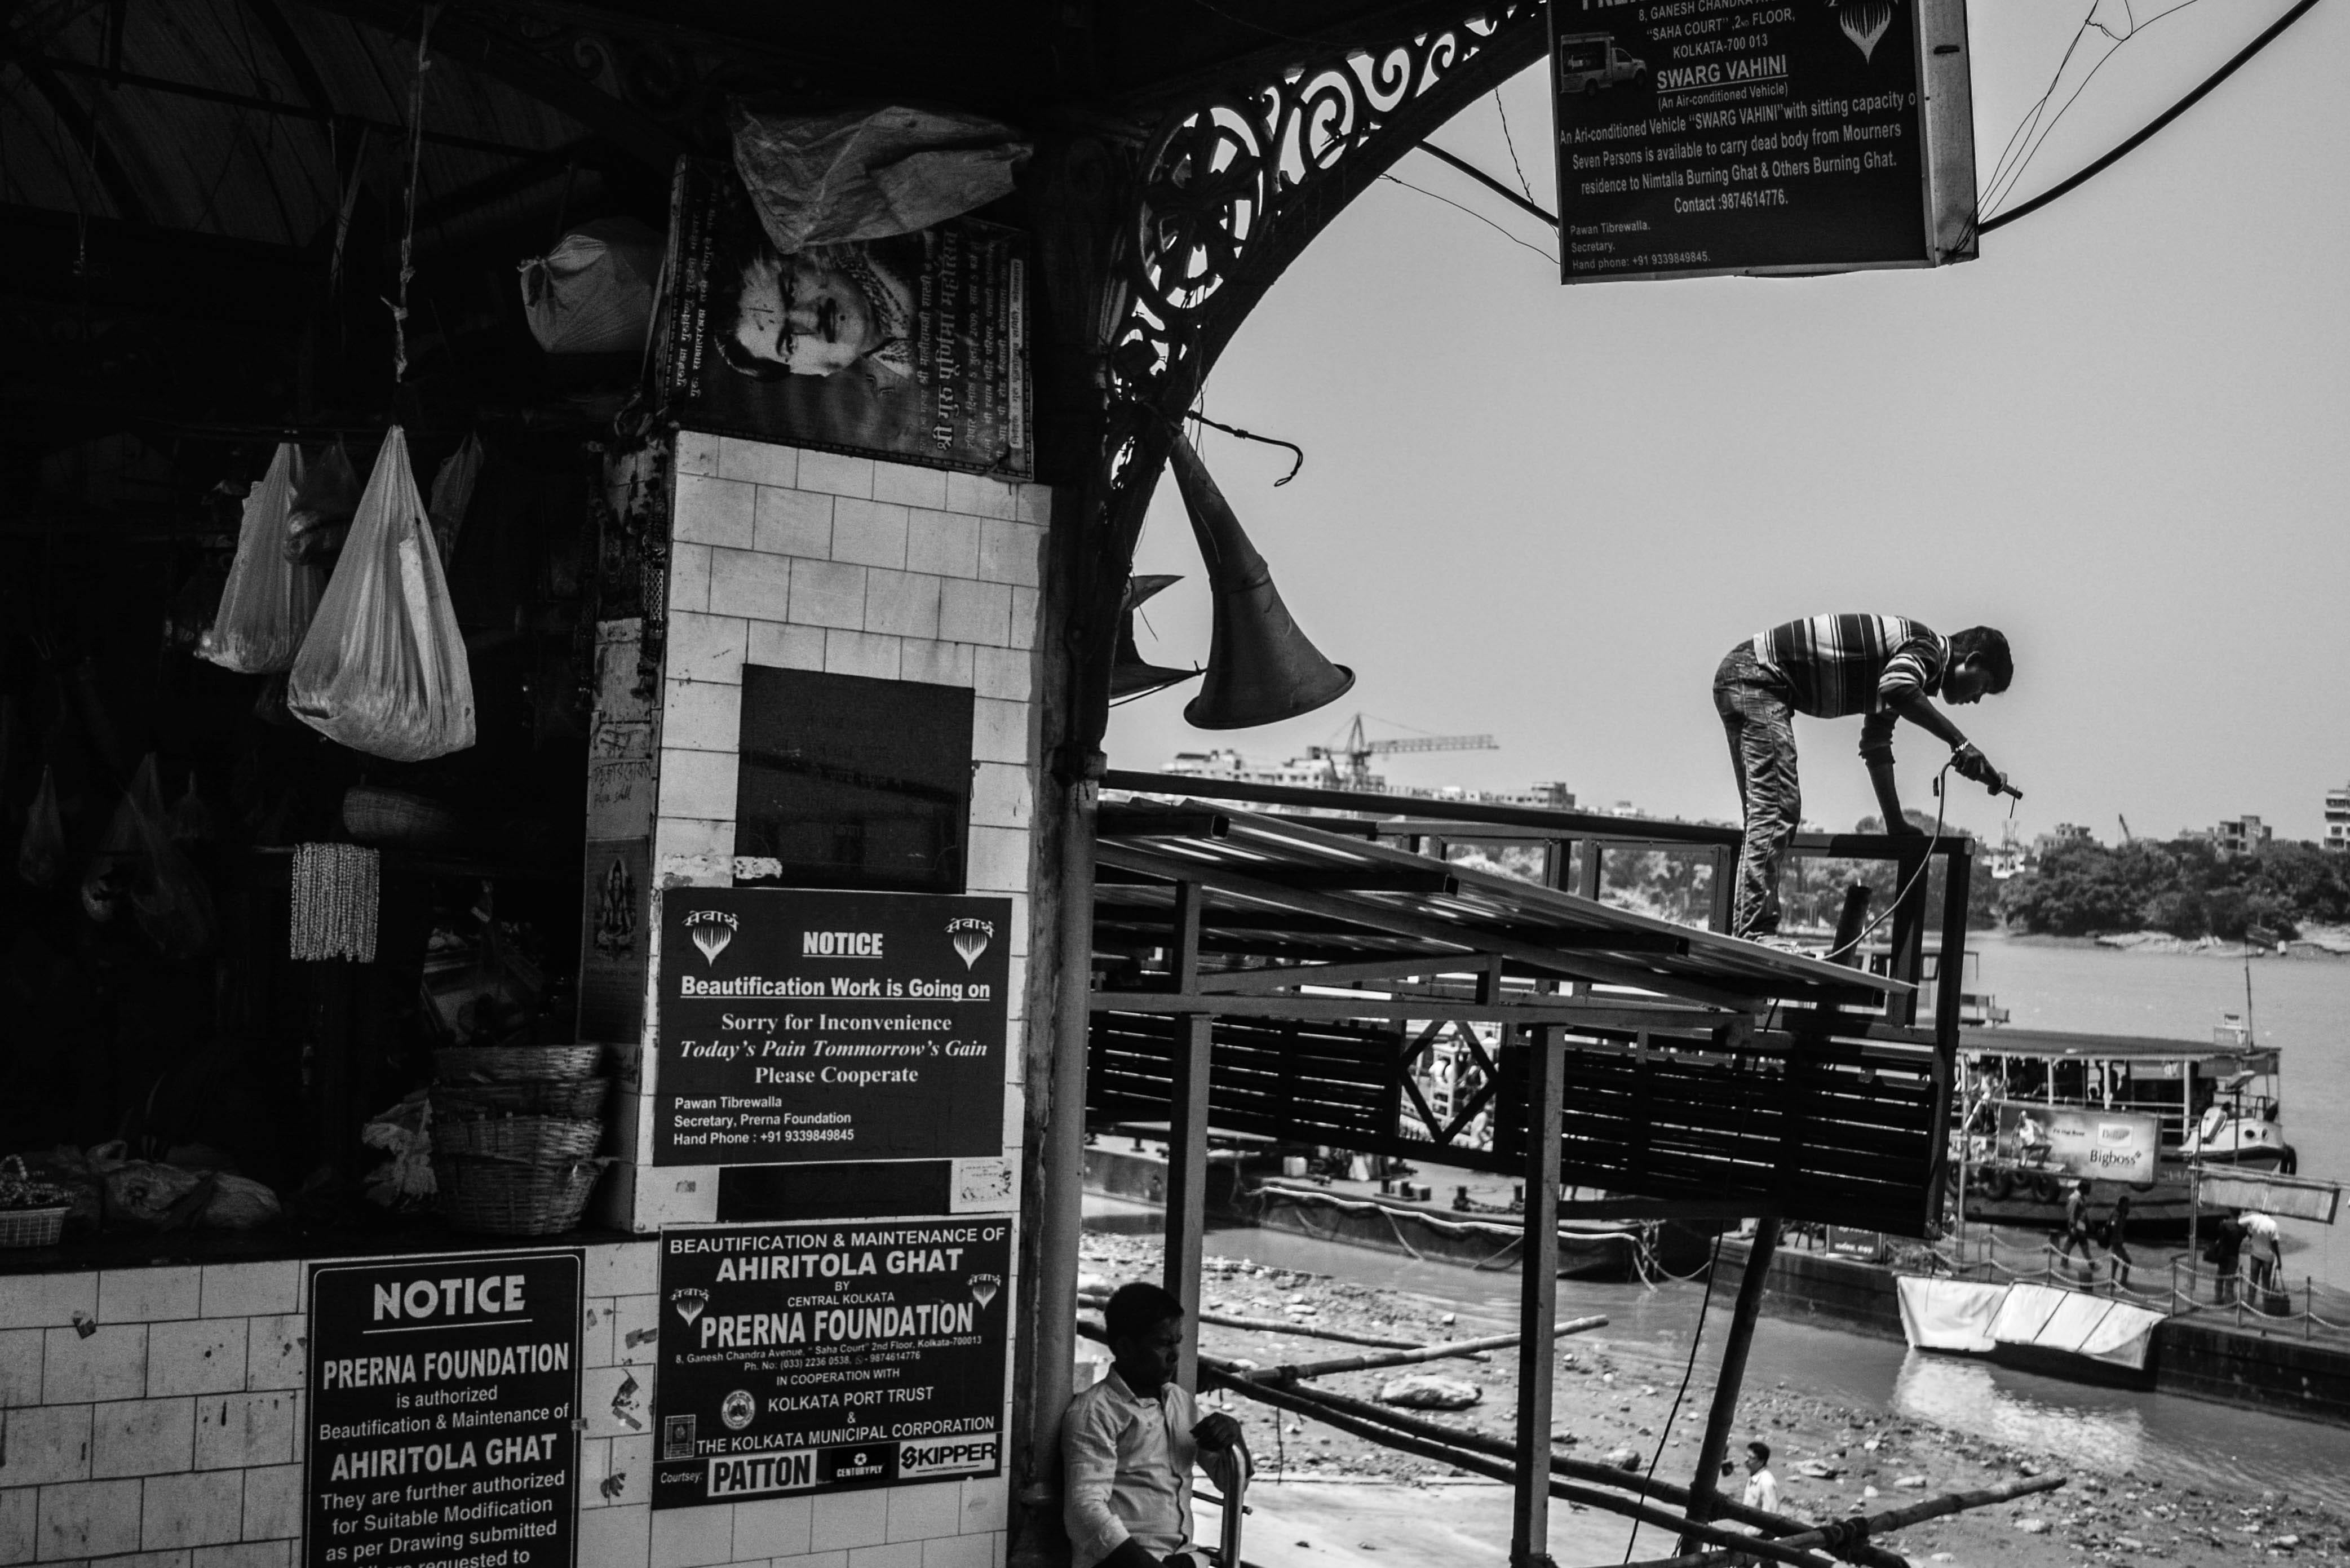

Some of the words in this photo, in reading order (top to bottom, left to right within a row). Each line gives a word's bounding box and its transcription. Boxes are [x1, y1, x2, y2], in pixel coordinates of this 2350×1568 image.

[1639, 9, 1647, 21] 8,
[1651, 1, 1694, 19] GANESH
[1647, 25, 1681, 40] “SAHA
[1753, 8, 1795, 25] FLOOR,
[1674, 37, 1745, 59] KOLKATA-700
[1750, 34, 1767, 47] 013
[1658, 64, 1720, 88] SWARG
[1726, 55, 1786, 79] VAHINI
[1658, 97, 1673, 112] (An
[1676, 87, 1746, 107] Air-conditioned
[1750, 82, 1787, 98] Vehicle)
[1560, 130, 1572, 144] An
[1575, 120, 1646, 143] Ari-conditioned
[1649, 116, 1685, 134] Vehicle
[1689, 109, 1736, 129] “SWARG
[1811, 98, 1848, 117] sitting
[1852, 91, 1903, 114] capacity
[1573, 154, 1600, 169] Seven
[1603, 151, 1642, 166] Persons
[1645, 147, 1654, 162] is
[1657, 141, 1702, 161] available
[1706, 143, 1716, 155] to
[1720, 140, 1747, 156] carry
[1751, 133, 1777, 151] dead
[1781, 130, 1808, 150] body
[1812, 129, 1839, 144] from
[1843, 124, 1901, 141] Mourners
[1582, 178, 1626, 194] residence
[1630, 176, 1639, 190] to
[1643, 171, 1683, 189] Nimtalla
[1687, 167, 1728, 186] Burning
[1732, 164, 1758, 180] Ghat
[1761, 162, 1769, 178] &
[1773, 160, 1809, 177] Others
[1813, 154, 1860, 174] Burning
[1864, 151, 1896, 168] Ghat.
[1675, 196, 1715, 213] Contact
[1571, 225, 1597, 234] Pawan
[1601, 220, 1650, 233] Tibrewalla.
[1572, 242, 1615, 253] Secretary.
[1573, 259, 1595, 269] Hand
[1599, 258, 1628, 270] phone:
[1633, 255, 1648, 265] +91
[937, 384, 960, 420] गुरु
[932, 423, 953, 450] श्री
[803, 932, 883, 955] NOTICE
[682, 976, 825, 995] Beautification
[831, 978, 880, 996] Work
[887, 978, 902, 996] is
[909, 979, 963, 1002] Going
[968, 985, 990, 997] on
[722, 1014, 777, 1034] Sorry
[785, 1014, 813, 1029] for
[820, 1015, 951, 1030] Inconvenience
[681, 1040, 755, 1061] Today’s
[762, 1040, 805, 1056] Pain
[945, 1040, 987, 1056] Gain
[756, 1068, 815, 1083] Please
[821, 1067, 918, 1087] Cooperate
[675, 1097, 716, 1109] Pawan
[720, 1096, 781, 1108] Tibrewalla
[675, 1115, 736, 1128] Secretary,
[741, 1114, 780, 1125] Prerna
[784, 1112, 851, 1124] Foundation
[674, 1133, 706, 1145] Hand
[710, 1132, 749, 1144] Phone
[760, 1131, 780, 1142] +91
[785, 1129, 854, 1142] 9339849845
[2090, 1149, 2136, 1168] Bigboss
[671, 1234, 826, 1253] BEAUTIFICATION
[833, 1233, 845, 1247] &
[851, 1228, 977, 1246] MAINTENANCE
[983, 1228, 1005, 1241] OF
[716, 1252, 877, 1281] AHIRITOLA
[887, 1248, 963, 1273] GHAT
[374, 1275, 525, 1320] NOTICE
[835, 1281, 849, 1291] BY
[787, 1295, 839, 1307] CENTRAL
[843, 1292, 895, 1304] KOLKATA
[701, 1312, 806, 1348] PRERNA
[815, 1302, 973, 1341] FOUNDATION
[687, 1353, 723, 1363] Ganesh
[726, 1350, 765, 1360] Chandra
[815, 1345, 837, 1354] Saha
[872, 1342, 888, 1350] 2nd
[744, 1362, 758, 1371] Ph.
[806, 1357, 826, 1367] 2236
[324, 1355, 416, 1389] PRERNA
[425, 1343, 568, 1381] FOUNDATION
[777, 1376, 787, 1385] IN
[791, 1370, 870, 1385] COOPERATION
[873, 1368, 900, 1379] WITH
[397, 1393, 409, 1408] is
[415, 1385, 497, 1406] authorized
[769, 1394, 839, 1411] KOLKATA
[844, 1390, 883, 1406] PORT
[888, 1387, 933, 1402] TRUST
[320, 1417, 430, 1439] Beautification
[436, 1414, 446, 1429] &
[453, 1408, 549, 1427] Maintenance
[554, 1403, 568, 1418] of
[848, 1412, 856, 1424] &
[697, 1438, 726, 1454] THE
[732, 1433, 804, 1451] KOLKATA
[809, 1426, 887, 1444] MUNICIPAL
[892, 1416, 994, 1437] CORPORATION
[331, 1442, 476, 1481] AHIRITOLA
[486, 1433, 556, 1465] GHAT
[901, 1442, 997, 1469] SKIPPER
[661, 1472, 702, 1483] Courtsey:
[714, 1455, 810, 1492] PATTON
[321, 1494, 365, 1511] They
[372, 1491, 400, 1505] are
[406, 1482, 467, 1501] further
[472, 1470, 564, 1494] authorized
[333, 1519, 358, 1534] for
[365, 1509, 438, 1530] Suitable
[445, 1498, 552, 1522] Modification
[326, 1548, 347, 1561] as
[354, 1543, 383, 1562] per
[390, 1532, 463, 1553] Drawing
[470, 1520, 556, 1544] submitted
[513, 1549, 530, 1563] to
